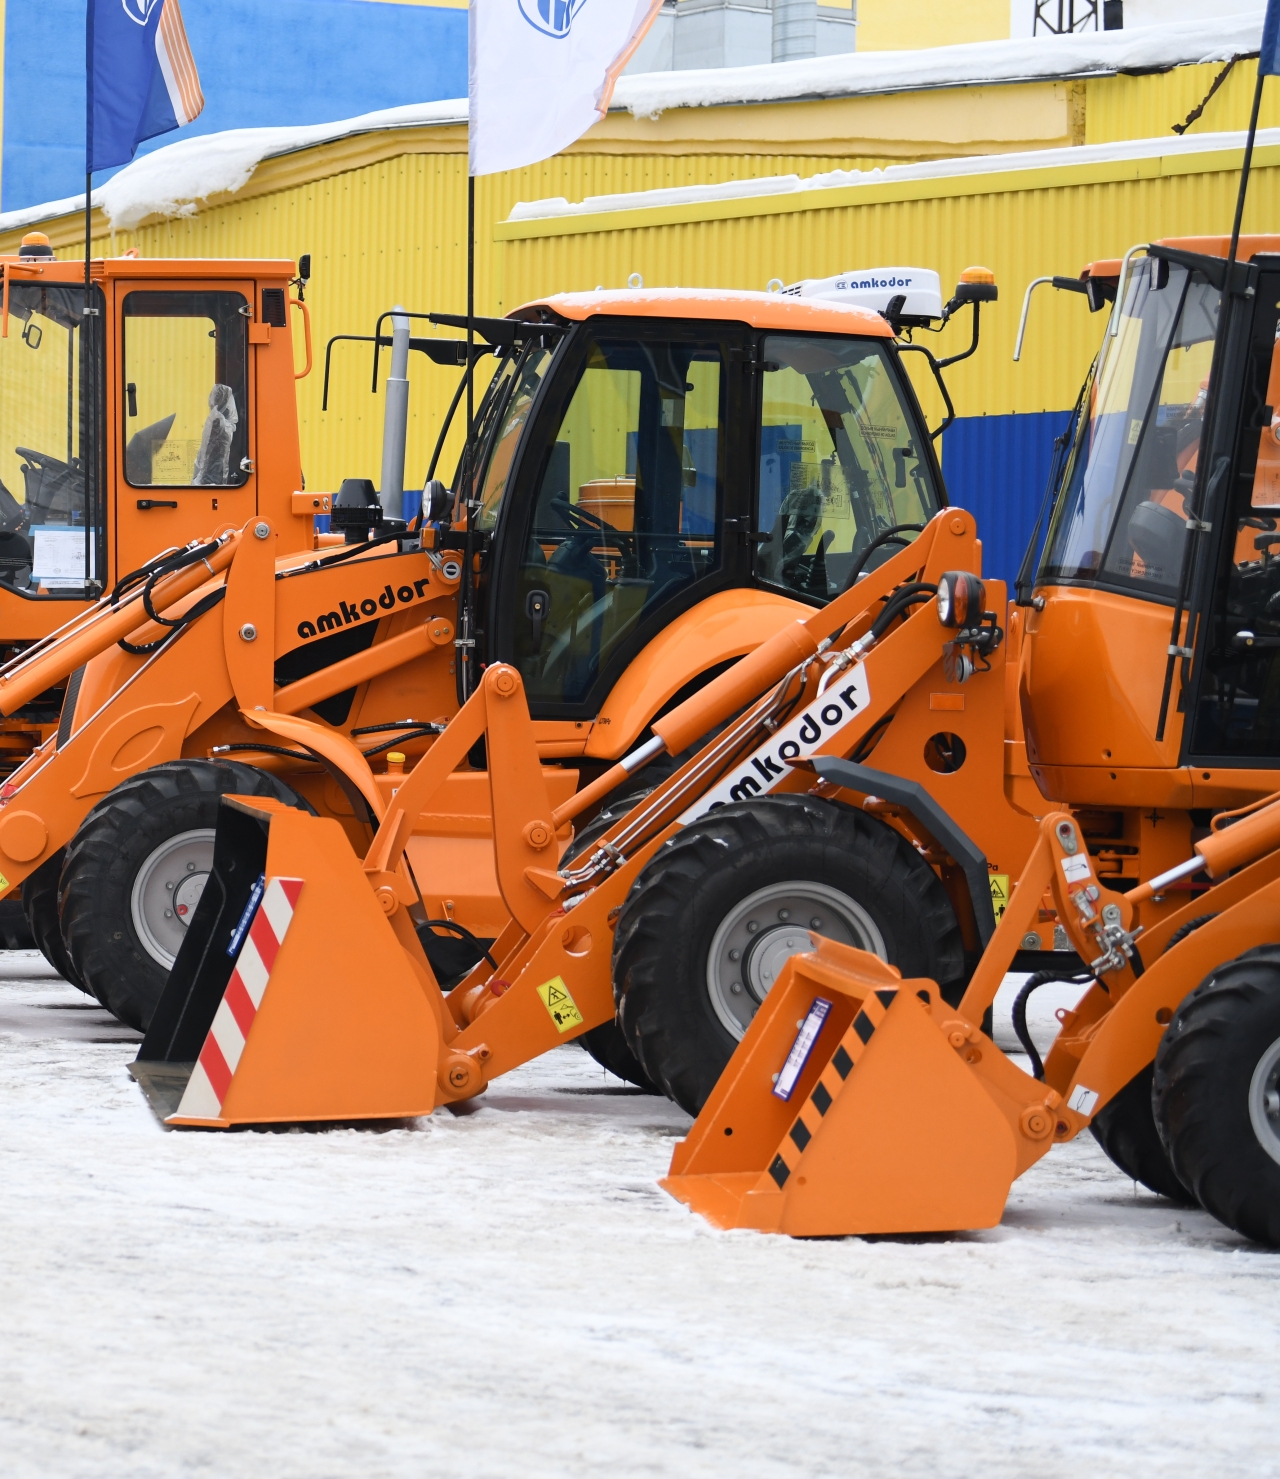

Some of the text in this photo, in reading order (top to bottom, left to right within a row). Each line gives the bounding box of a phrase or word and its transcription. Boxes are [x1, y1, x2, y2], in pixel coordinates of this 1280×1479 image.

[850, 276, 912, 289] amkodor
[297, 578, 430, 639] amkodor
[708, 684, 857, 811] mkodor
